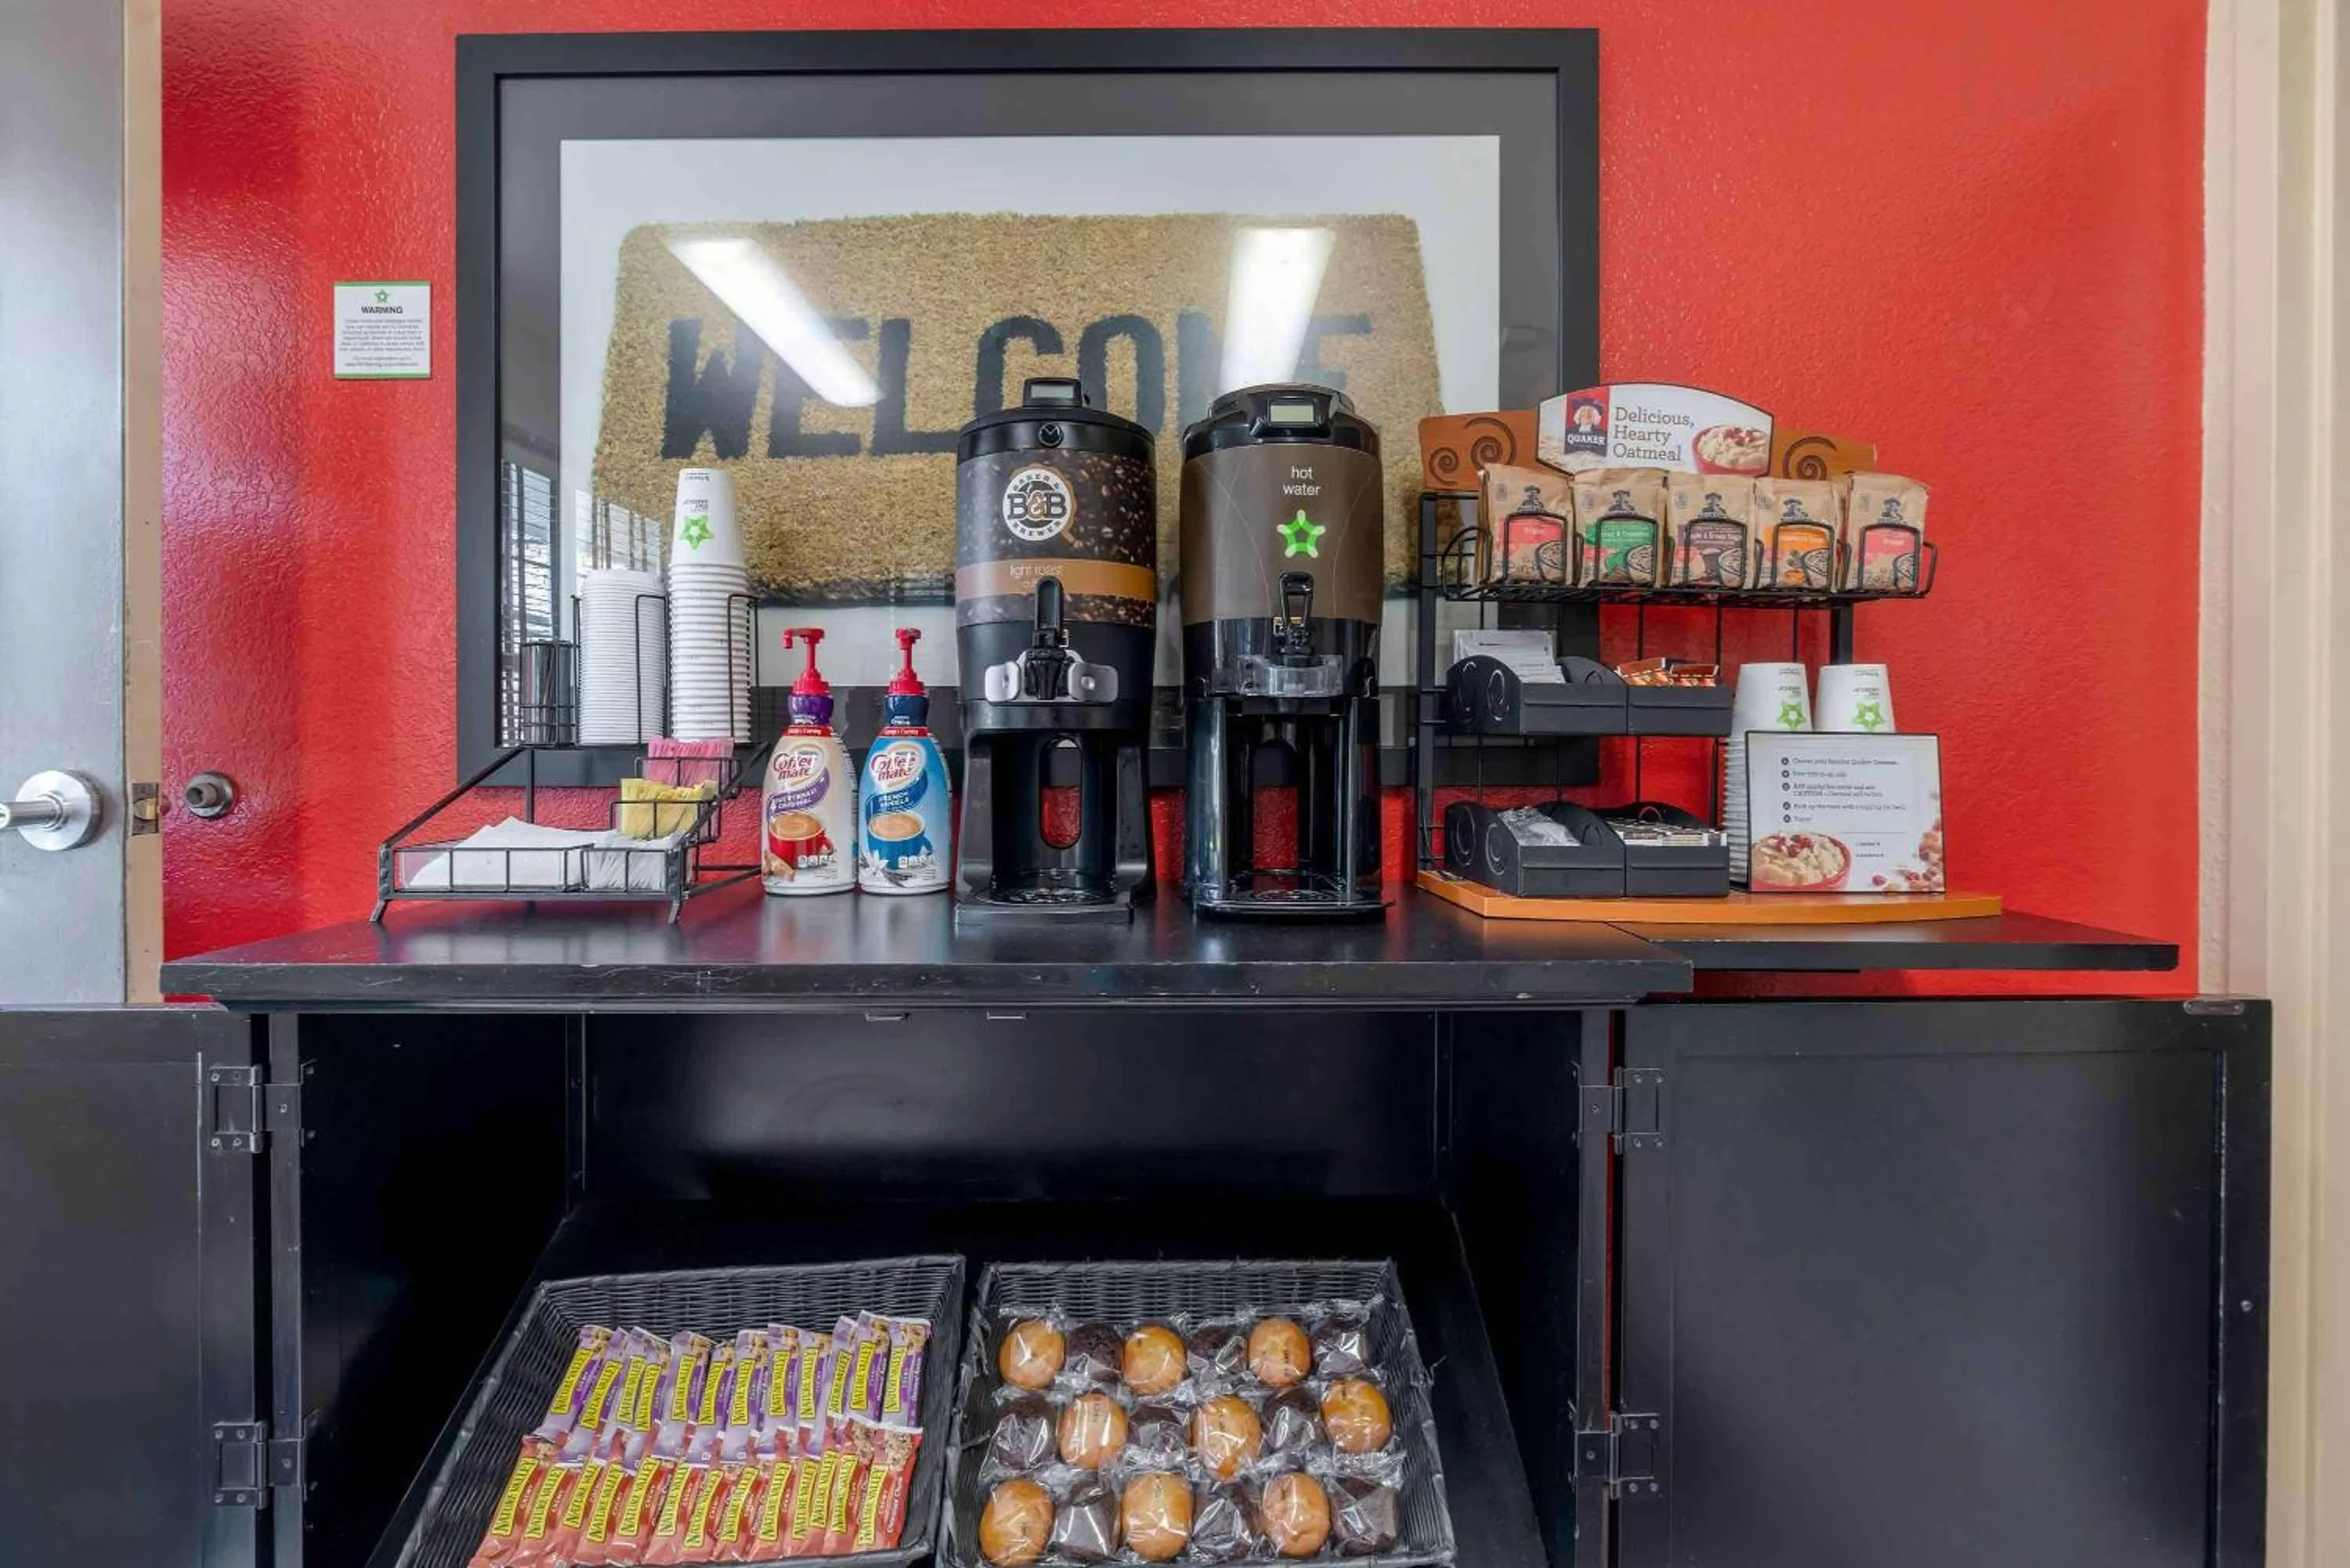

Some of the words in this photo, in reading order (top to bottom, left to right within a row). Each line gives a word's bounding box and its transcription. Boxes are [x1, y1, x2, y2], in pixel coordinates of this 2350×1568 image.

[1614, 406, 1694, 429] Delicious,
[1567, 433, 1605, 446] QUAKER
[1613, 442, 1681, 461] Oatmeal
[1614, 425, 1671, 446] Hearty
[1291, 464, 1313, 479] hot
[1007, 491, 1067, 520] B&B
[1282, 482, 1321, 496] water
[1010, 564, 1032, 580] light
[1034, 565, 1063, 576] roast
[672, 1386, 686, 1419] NATURE
[732, 1390, 746, 1422] NATURE
[770, 1382, 784, 1413] NATURE
[801, 1382, 813, 1417] NATURE
[852, 1374, 866, 1407] NATURE
[885, 1378, 898, 1410] NATURE
[566, 1485, 588, 1525] NATURE
[580, 1464, 598, 1486] VALL
[811, 1486, 827, 1525] NATURE
[494, 1494, 519, 1533] NATURE
[527, 1500, 550, 1536] NATURE
[589, 1498, 609, 1539] NATURE
[620, 1494, 642, 1533] NATURE
[761, 1499, 779, 1538] NATURE
[794, 1498, 807, 1537] NATURE
[859, 1503, 876, 1543] NATURE
